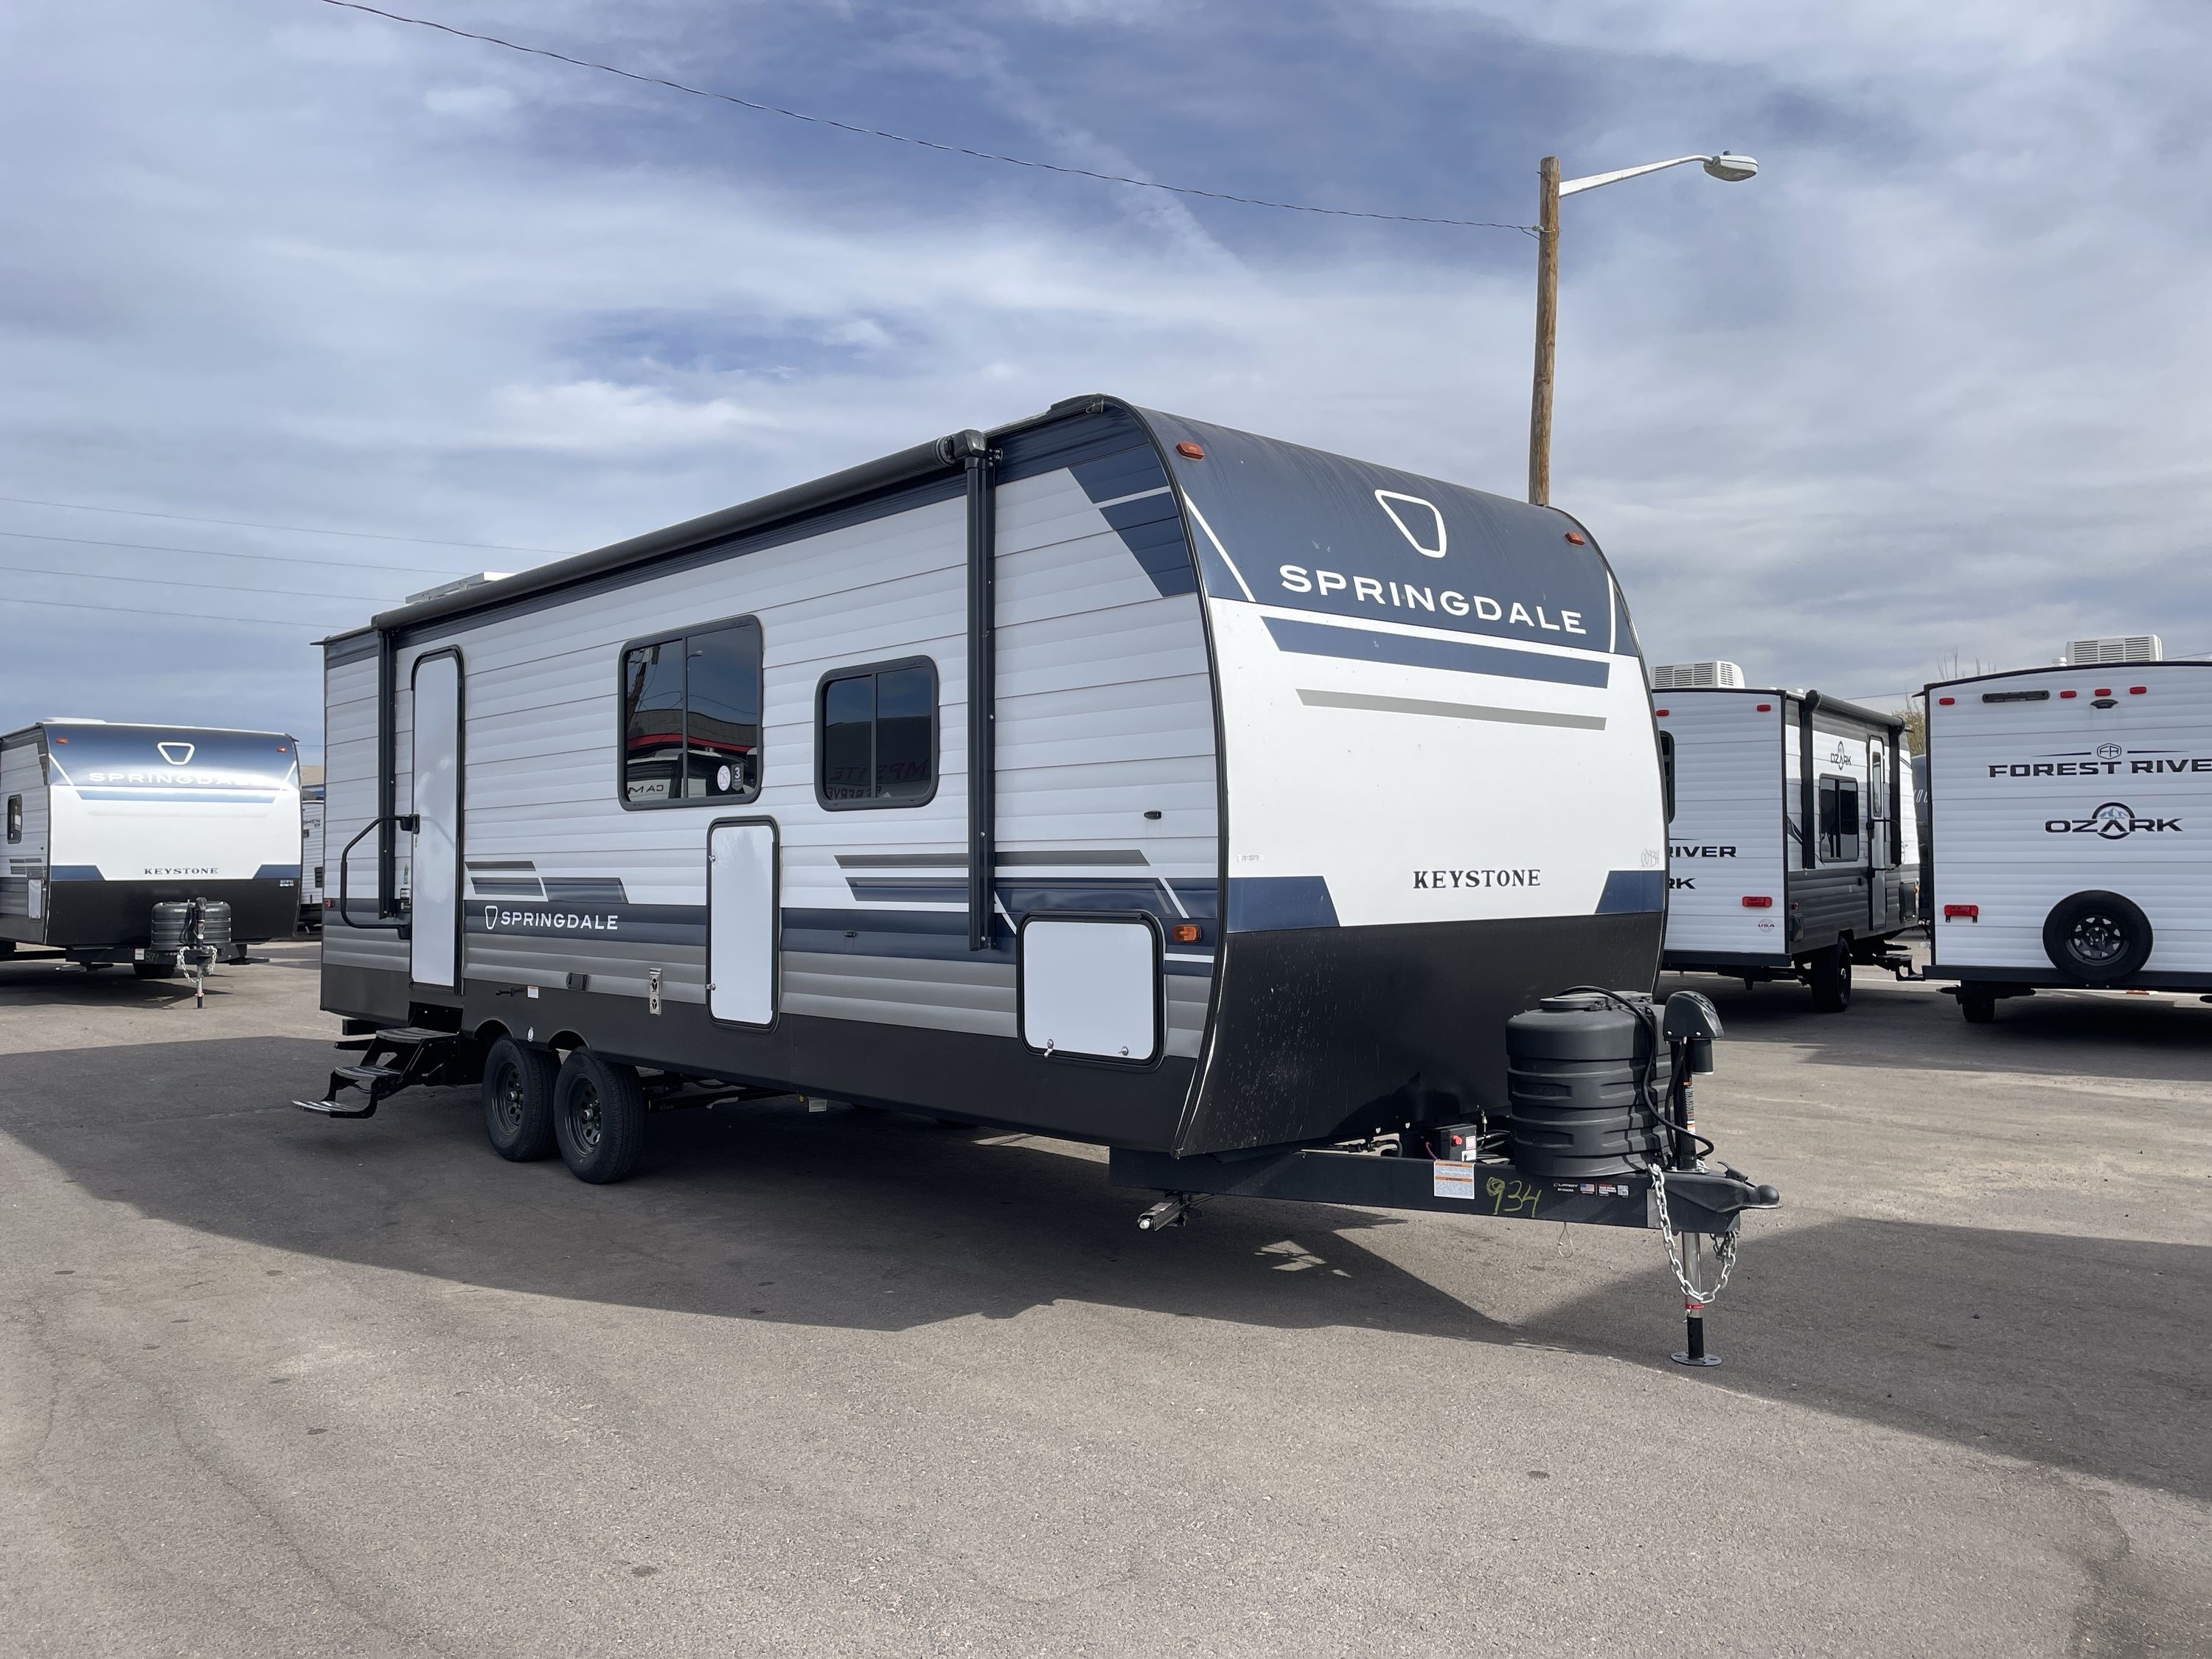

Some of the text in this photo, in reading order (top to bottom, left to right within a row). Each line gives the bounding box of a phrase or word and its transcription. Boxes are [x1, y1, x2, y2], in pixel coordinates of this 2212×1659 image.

[1279, 564, 1586, 634] SPRINGDALE
[1830, 753, 1851, 766] OZARK
[734, 767, 740, 779] 3
[1988, 761, 2122, 778] FOREST
[2045, 817, 2183, 833] OZARK
[145, 867, 218, 875] KEYSTONE
[1413, 869, 1541, 889] KEYSTONE
[501, 911, 618, 930] SPRINGDALE
[1486, 1177, 1543, 1218] 934
